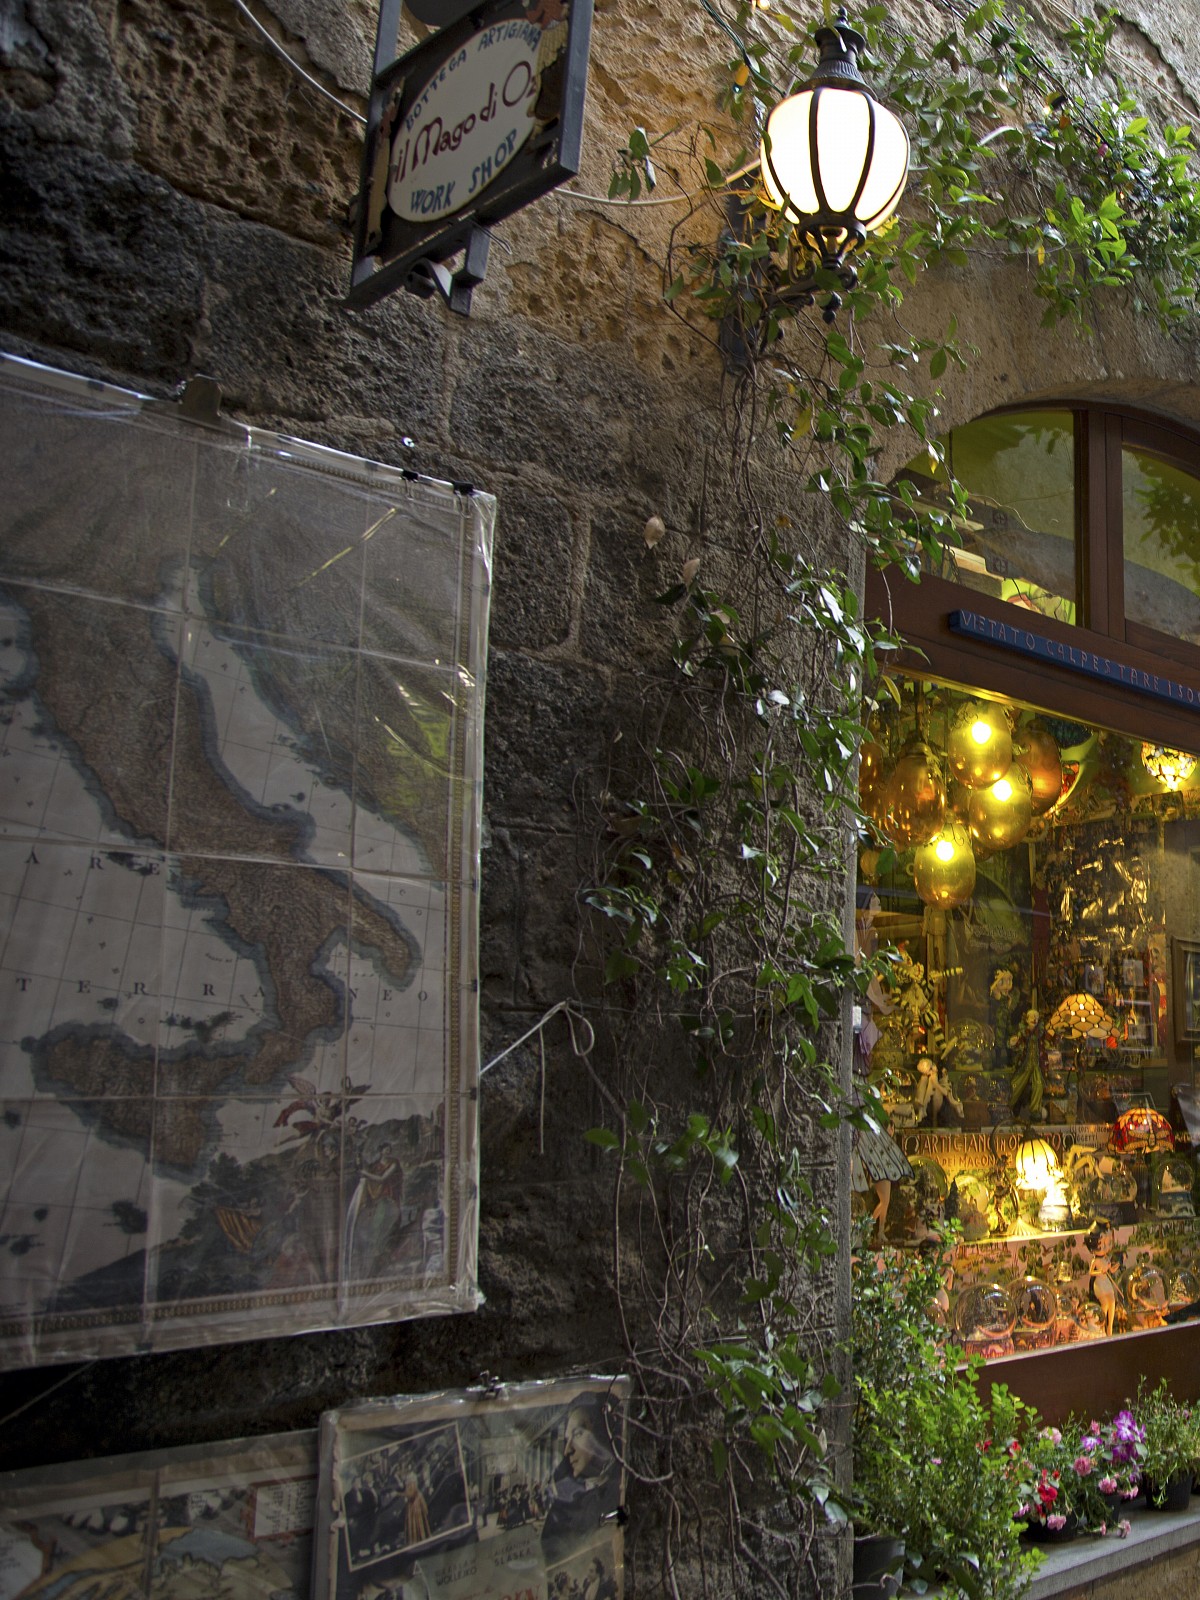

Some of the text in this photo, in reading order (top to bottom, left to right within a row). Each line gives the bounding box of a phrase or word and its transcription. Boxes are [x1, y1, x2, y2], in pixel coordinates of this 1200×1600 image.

[405, 24, 543, 132] BOTTEGA ARTIGIANA
[410, 128, 518, 214] WORK SHOP
[411, 114, 476, 172] Mago
[480, 82, 498, 122] di
[960, 611, 1036, 650] VIETATO
[1046, 639, 1160, 692] CALPESTARE
